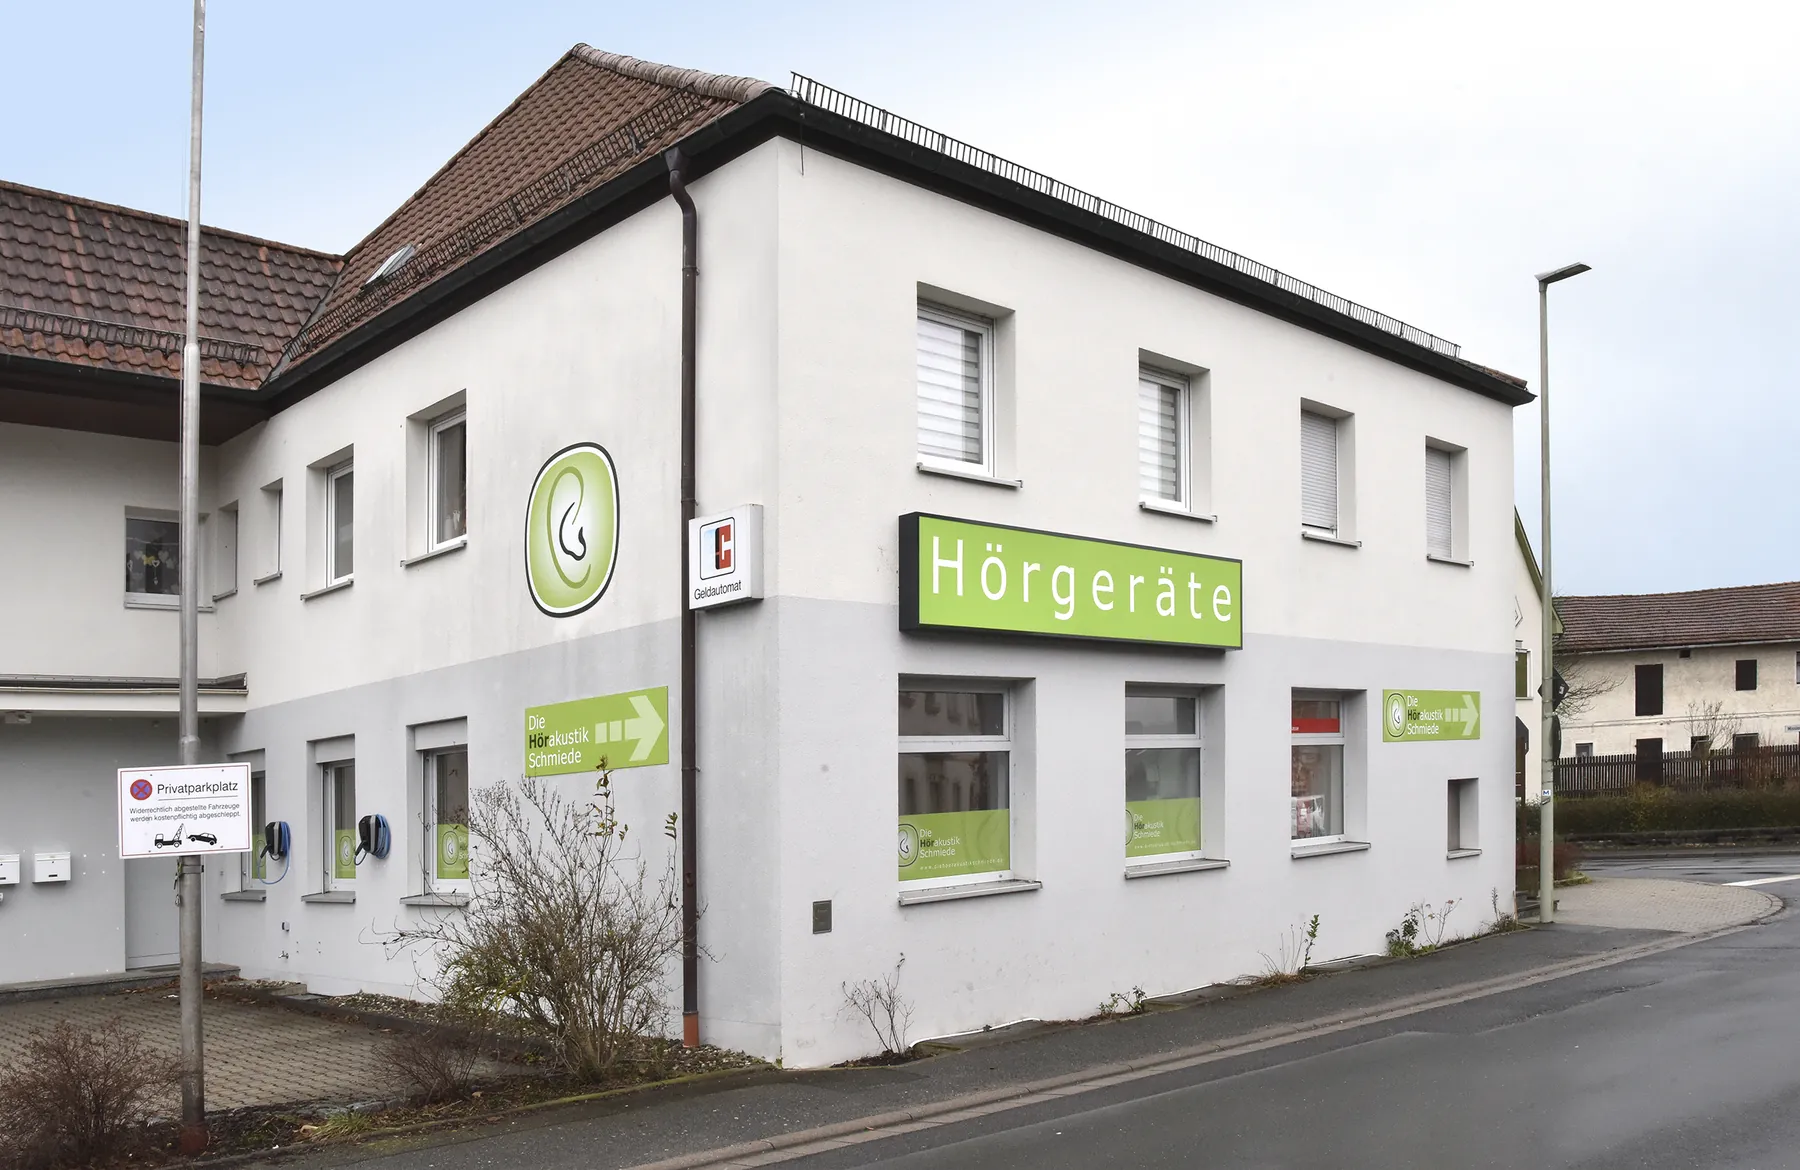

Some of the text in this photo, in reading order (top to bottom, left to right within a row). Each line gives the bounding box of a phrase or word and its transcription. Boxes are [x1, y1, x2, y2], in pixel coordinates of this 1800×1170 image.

[932, 536, 1232, 622] Hörgeräte
[694, 580, 742, 600] Geldautomat
[1407, 695, 1418, 707] Die
[1407, 708, 1443, 721] Hörakustik
[528, 715, 546, 731] Die
[1407, 722, 1439, 735] Schmiede
[529, 727, 590, 749] Hörakustik
[529, 748, 582, 768] Schmiede
[157, 781, 239, 796] Privatparkplatz
[129, 803, 240, 814] Widerrechtlich abgestellte Fahrzeuge
[154, 813, 198, 821] kostenpflichtig
[920, 828, 932, 838] Die
[920, 836, 961, 848] Hörakustik
[920, 847, 956, 859] Schmiede
